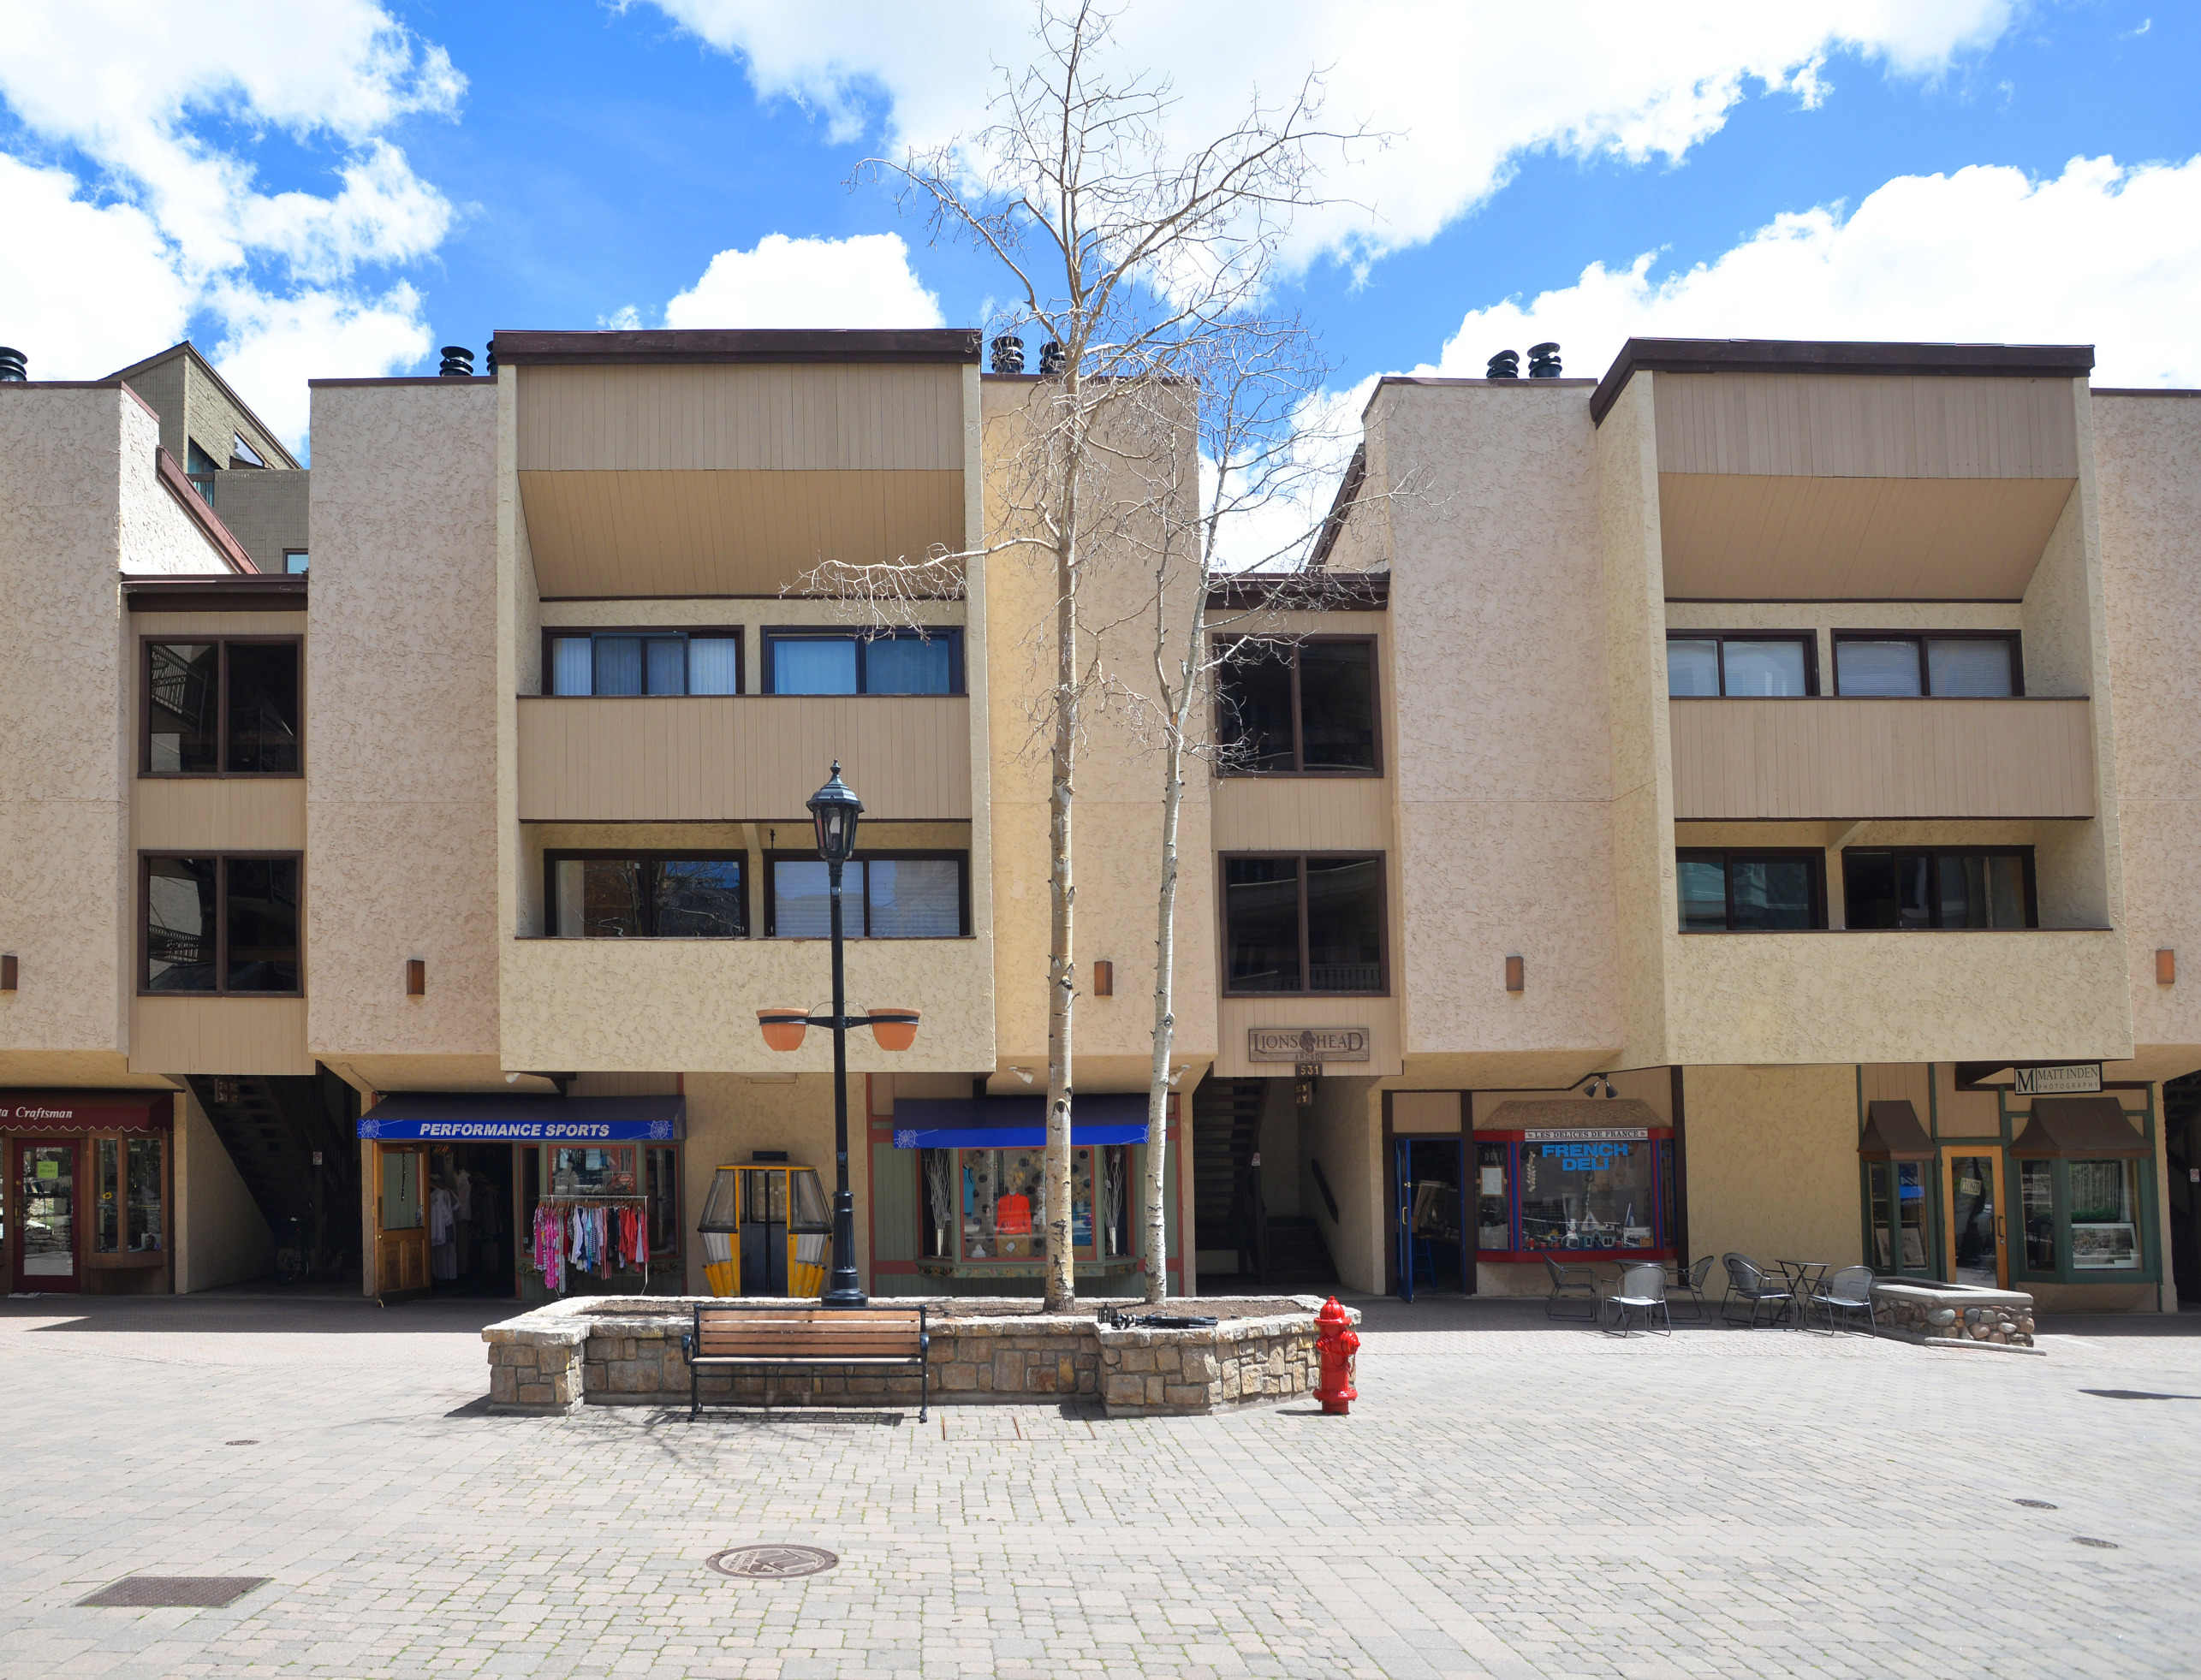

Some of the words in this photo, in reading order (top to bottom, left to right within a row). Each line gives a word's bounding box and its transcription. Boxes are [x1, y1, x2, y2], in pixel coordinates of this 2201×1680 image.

[1253, 1033, 1298, 1054] LIONS
[1316, 1032, 1363, 1052] HEAD
[1300, 1066, 1319, 1075] 531
[2037, 1068, 2064, 1081] MATT
[2067, 1066, 2098, 1079] INDEN
[2016, 1069, 2036, 1092] M
[2038, 1082, 2098, 1090] PHOTOGRAPHY
[15, 1107, 73, 1120] Craftsman
[419, 1123, 542, 1137] PERFORMANCE
[544, 1124, 610, 1137] SPORTS
[1542, 1143, 1628, 1158] FRENCH
[1562, 1158, 1609, 1172] DELI
[1960, 1179, 1980, 1194] CLOSED
